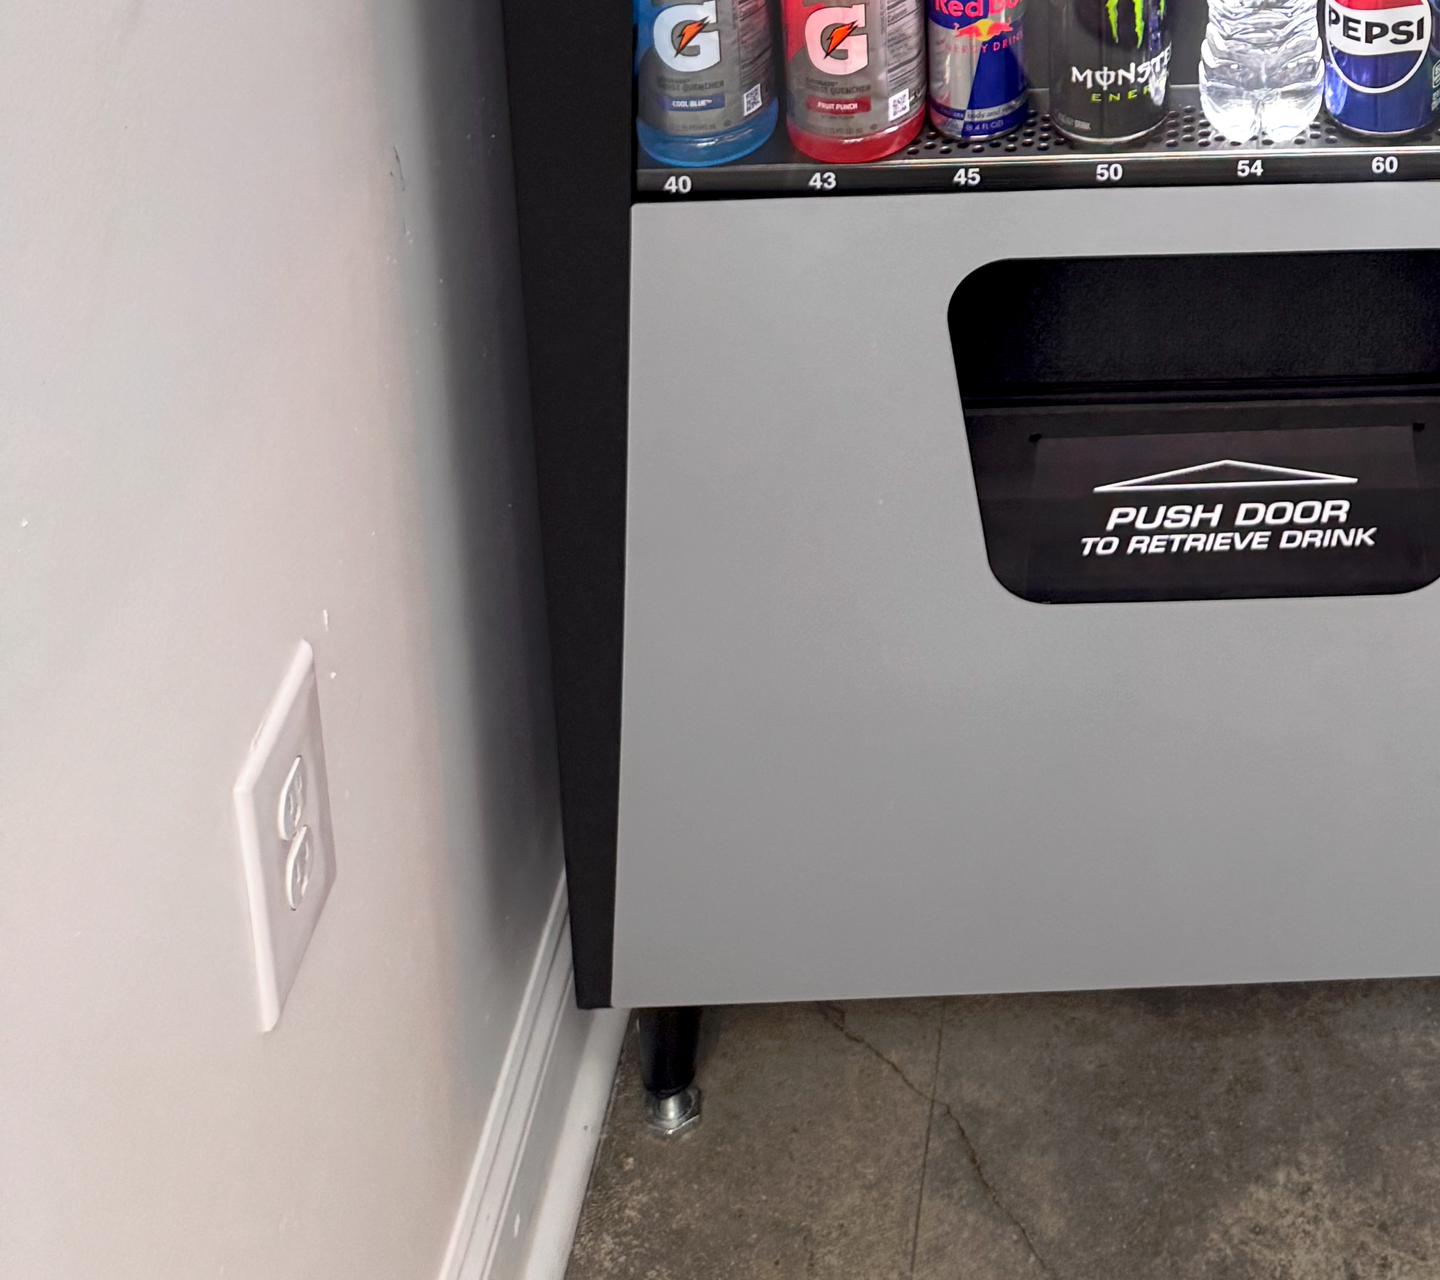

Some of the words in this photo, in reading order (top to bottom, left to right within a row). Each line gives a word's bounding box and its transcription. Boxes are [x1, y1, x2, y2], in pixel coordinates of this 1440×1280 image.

[652, 0, 722, 73] G
[1329, 11, 1425, 45] PEPSI
[804, 3, 870, 76] G
[1070, 40, 1172, 92] MONSTE
[671, 99, 689, 108] COOL
[689, 99, 706, 108] BLUE
[817, 100, 835, 110] FRUIT
[835, 102, 858, 111] PUNCH
[1095, 163, 1123, 182] 50
[1236, 159, 1264, 178] 54
[1371, 156, 1399, 174] 60
[663, 175, 693, 195] 40
[808, 171, 838, 190] 43
[952, 167, 981, 187] 45
[1105, 503, 1222, 531] PUSH
[1234, 499, 1351, 526] DOOR
[1081, 537, 1119, 557] TO
[1126, 531, 1270, 555] RETRIEVE
[1279, 526, 1378, 550] DRINK
